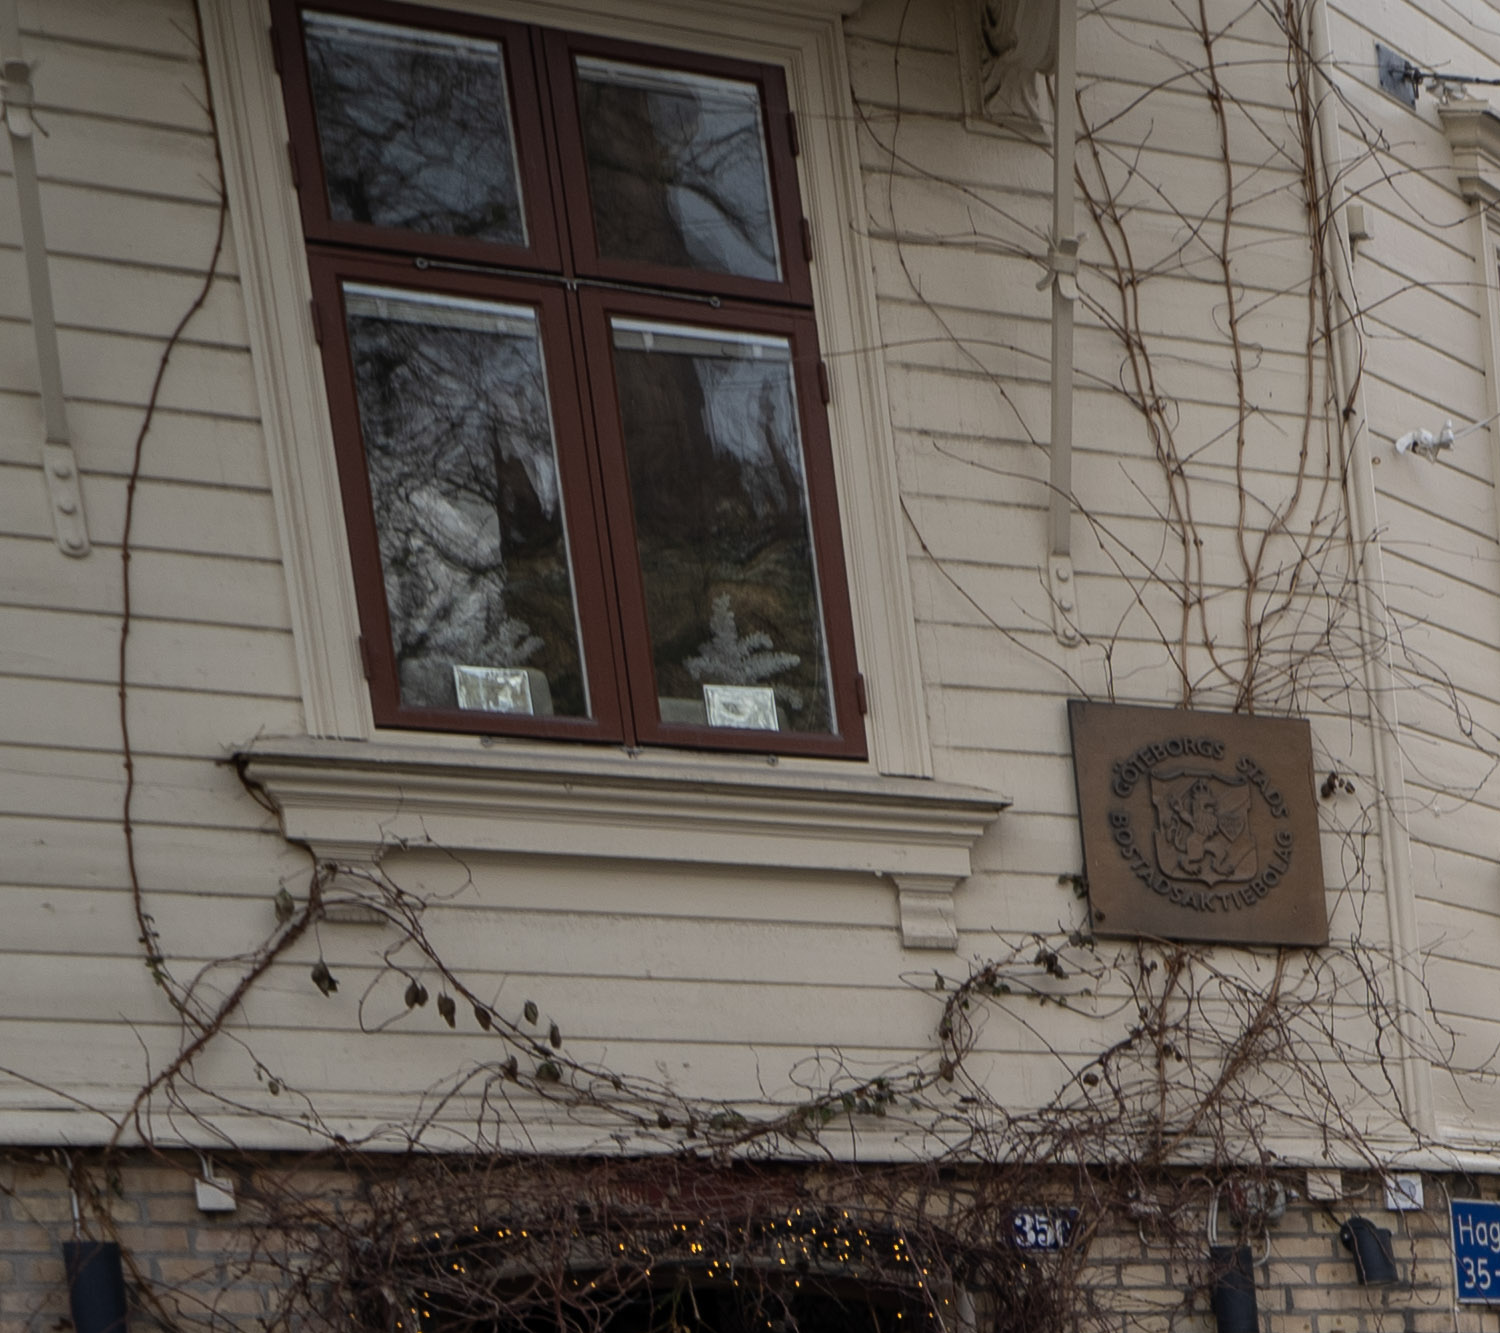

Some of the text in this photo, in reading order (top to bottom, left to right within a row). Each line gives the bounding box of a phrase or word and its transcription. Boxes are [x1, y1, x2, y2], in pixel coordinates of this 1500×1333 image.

[1112, 736, 1290, 820] GÖTEBORGS STADS
[1110, 810, 1293, 912] BOSTADSAKTIEBOLAG
